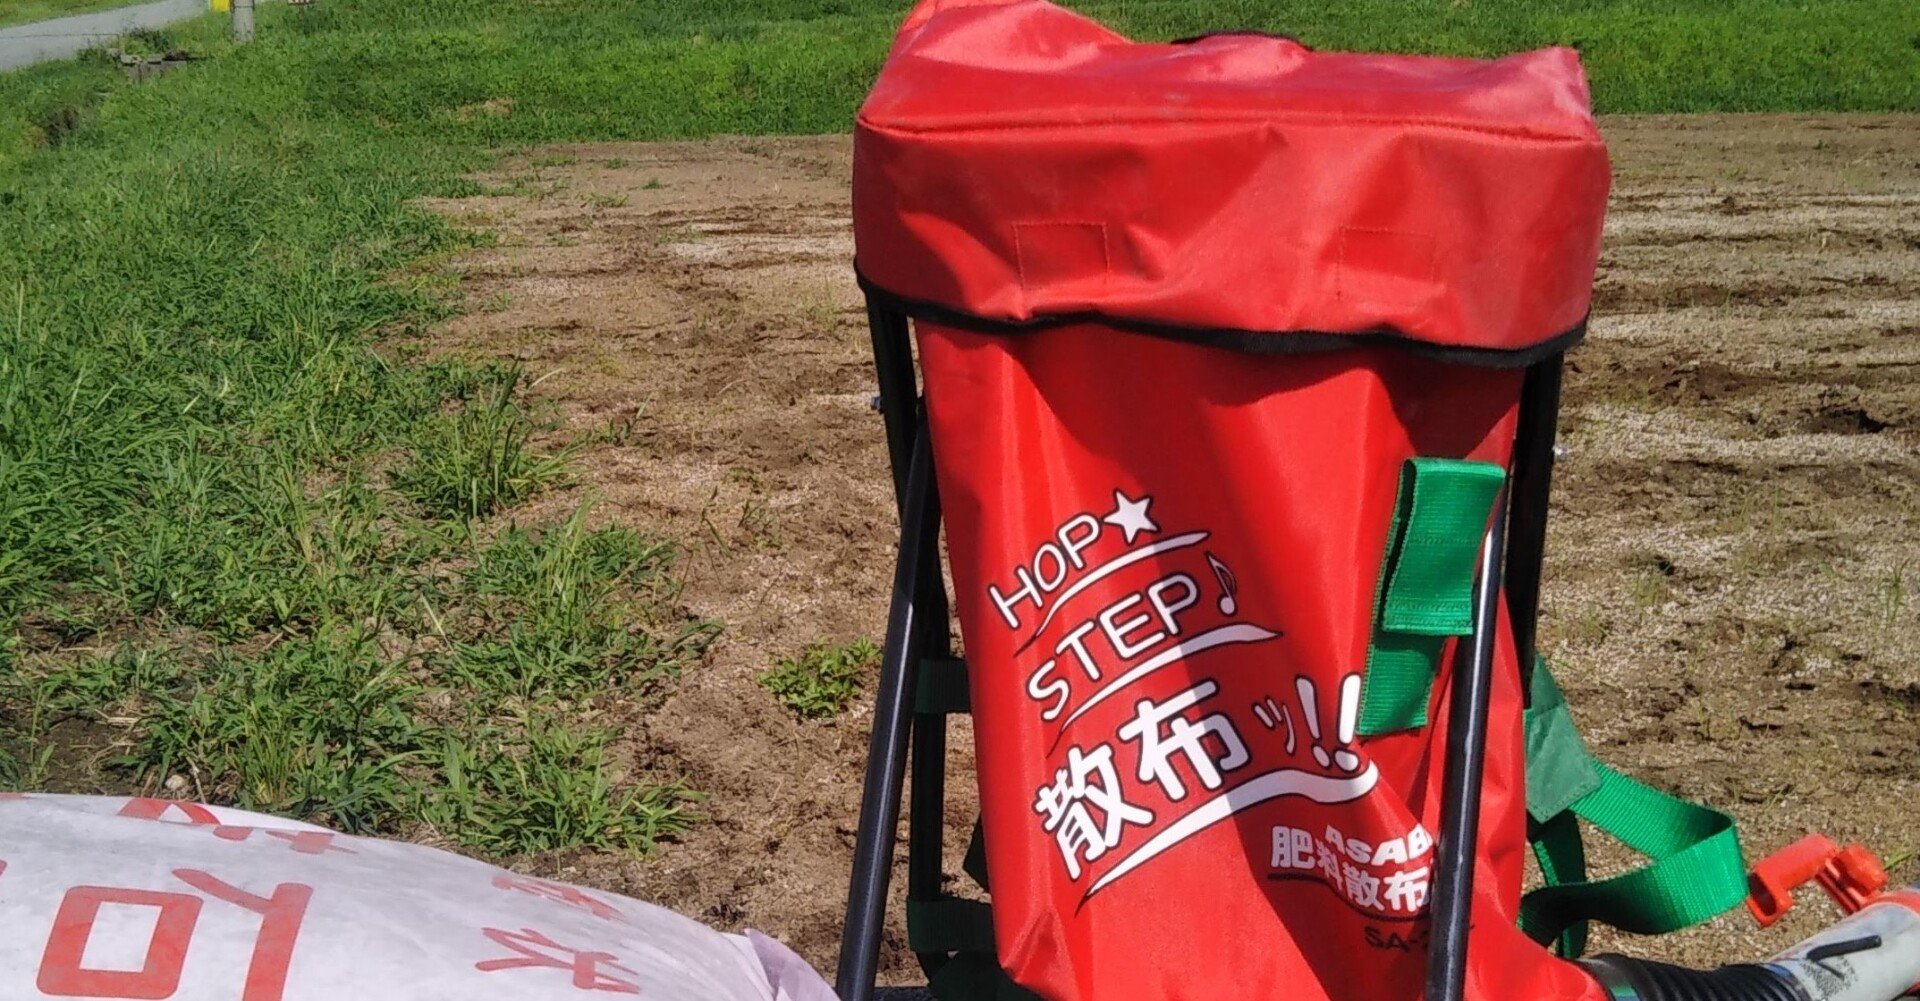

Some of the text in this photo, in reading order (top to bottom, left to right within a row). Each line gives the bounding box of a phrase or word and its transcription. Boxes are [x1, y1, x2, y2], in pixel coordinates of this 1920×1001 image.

[988, 512, 1101, 629] HOP
[1026, 573, 1200, 721] STEP
[1270, 825, 1431, 913] 肥料散布
[1325, 823, 1435, 867] ASAB
